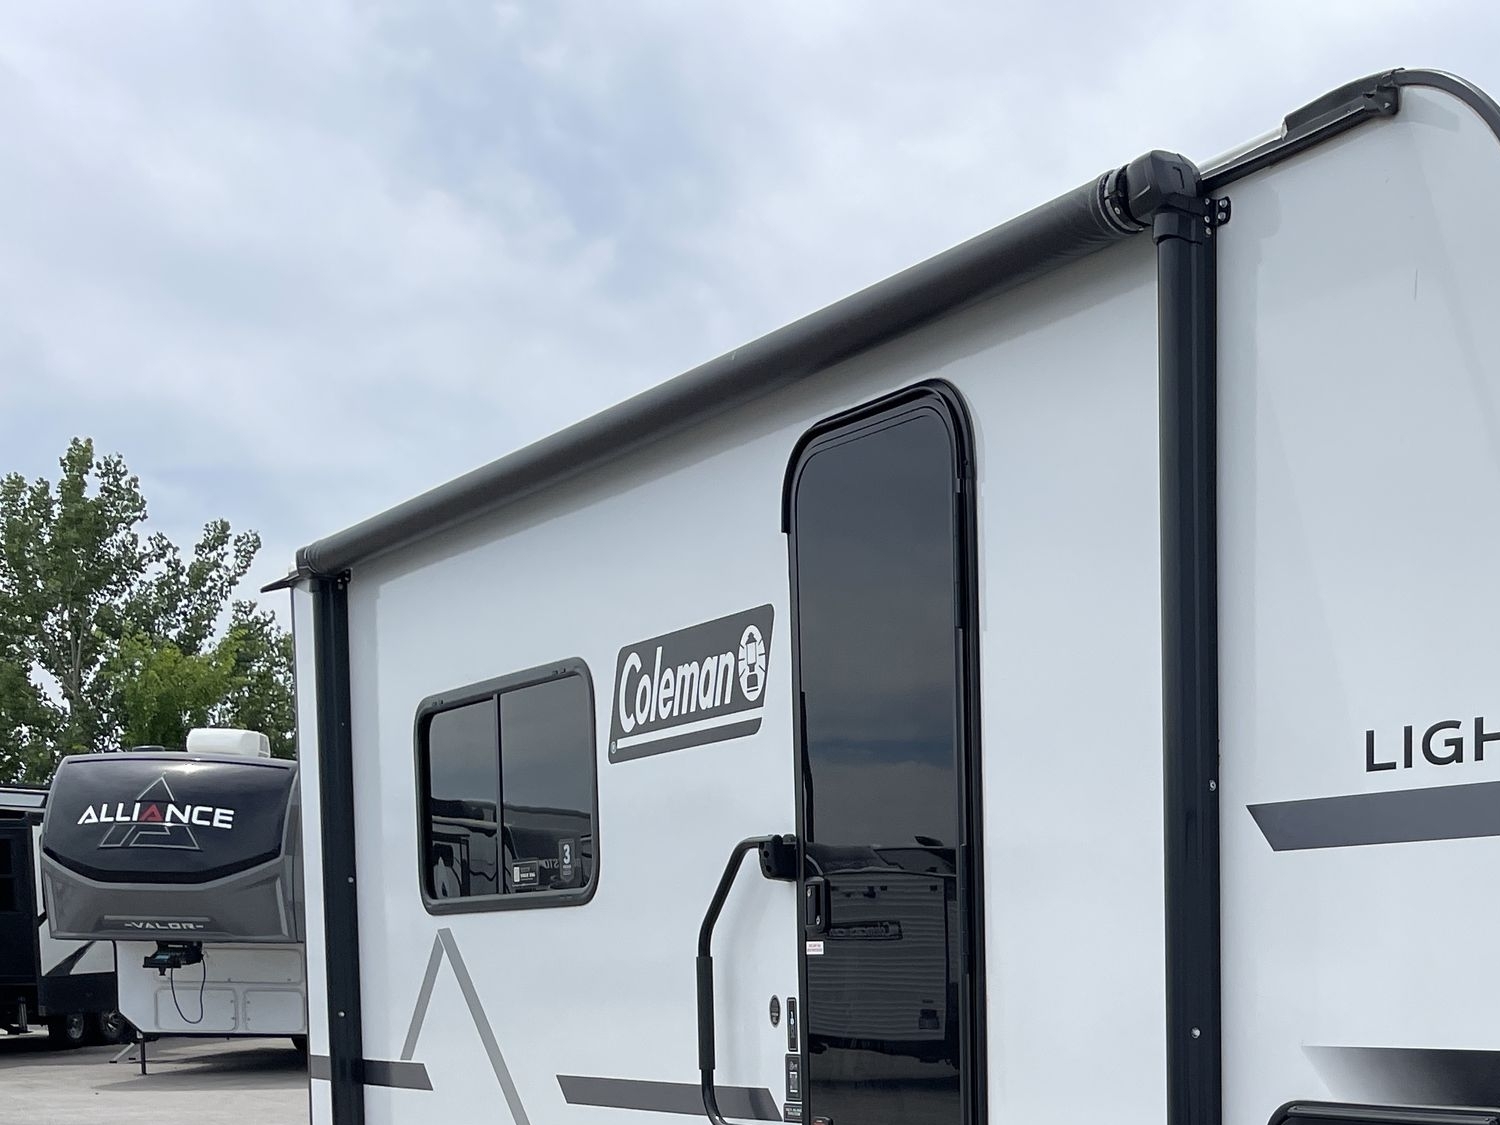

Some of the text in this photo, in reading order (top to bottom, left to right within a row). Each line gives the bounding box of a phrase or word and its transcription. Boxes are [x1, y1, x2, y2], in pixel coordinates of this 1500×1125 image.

[619, 645, 736, 733] Coleman
[77, 802, 235, 830] ALLIANCE
[563, 844, 571, 865] 3
